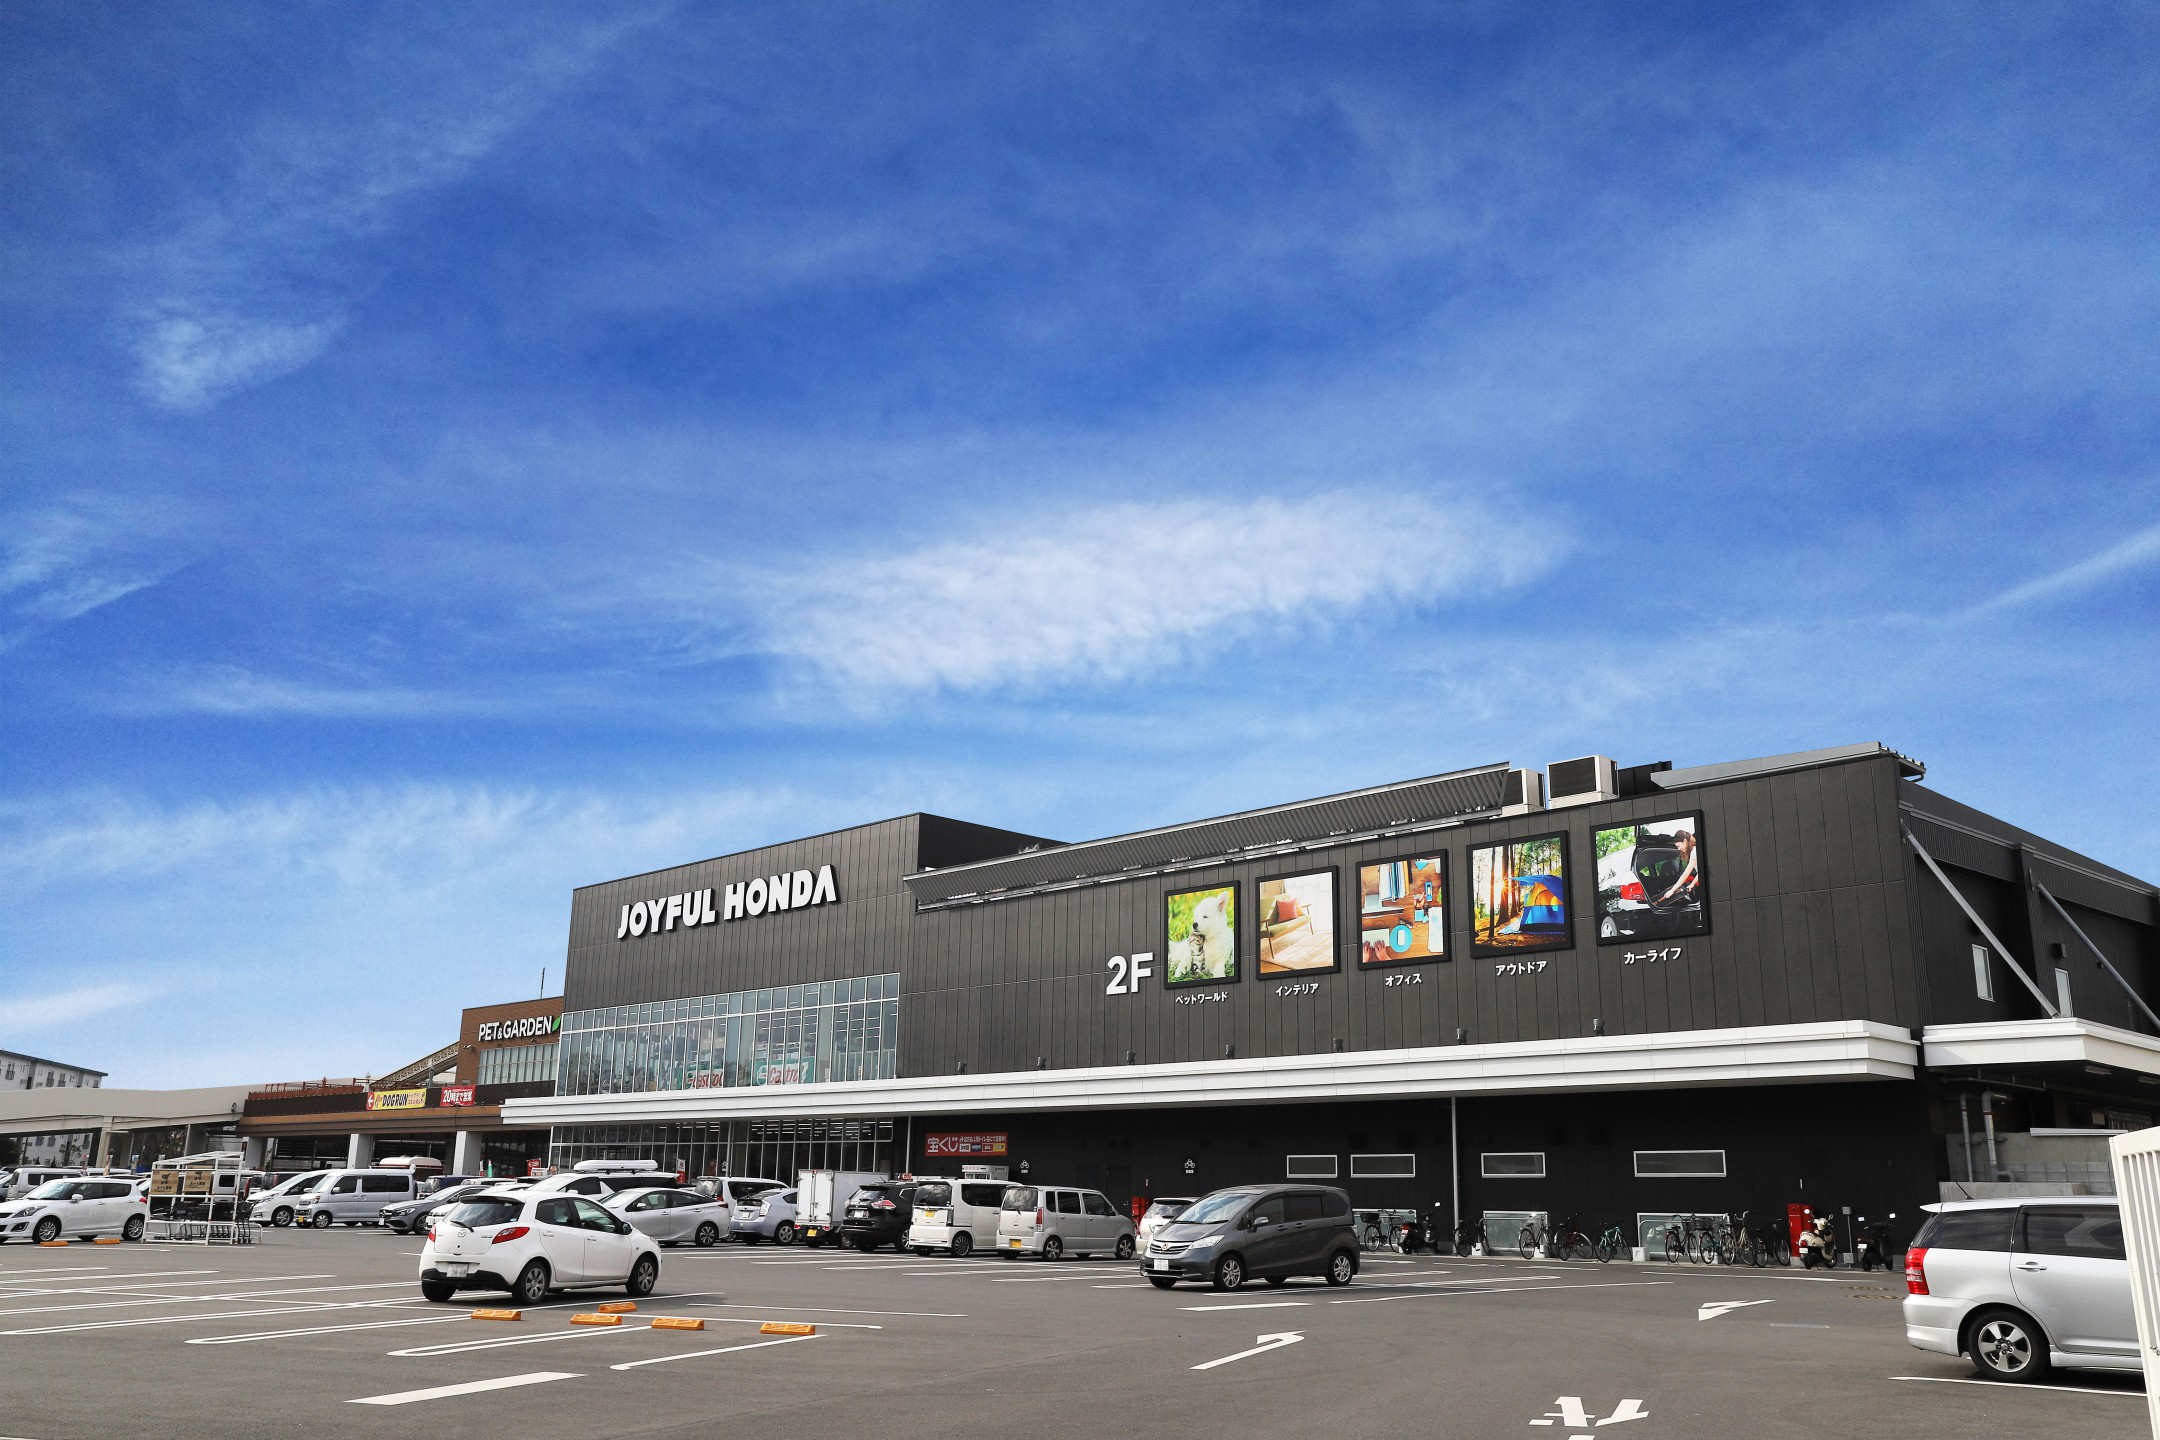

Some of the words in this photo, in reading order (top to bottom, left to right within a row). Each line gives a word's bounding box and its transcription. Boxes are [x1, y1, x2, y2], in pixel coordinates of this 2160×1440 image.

[618, 887, 715, 939] JOYFUL
[724, 865, 836, 921] HONDA
[1623, 947, 1682, 965] カーライフ
[1106, 952, 1154, 995] 2F
[1495, 960, 1547, 976] アウトドア
[1385, 972, 1422, 987] オフィス
[1175, 991, 1228, 1005] ペットワールド
[1275, 982, 1319, 997] インテリア
[478, 1015, 552, 1042] PET&GARDEN
[927, 1136, 959, 1153] 宝くじ
